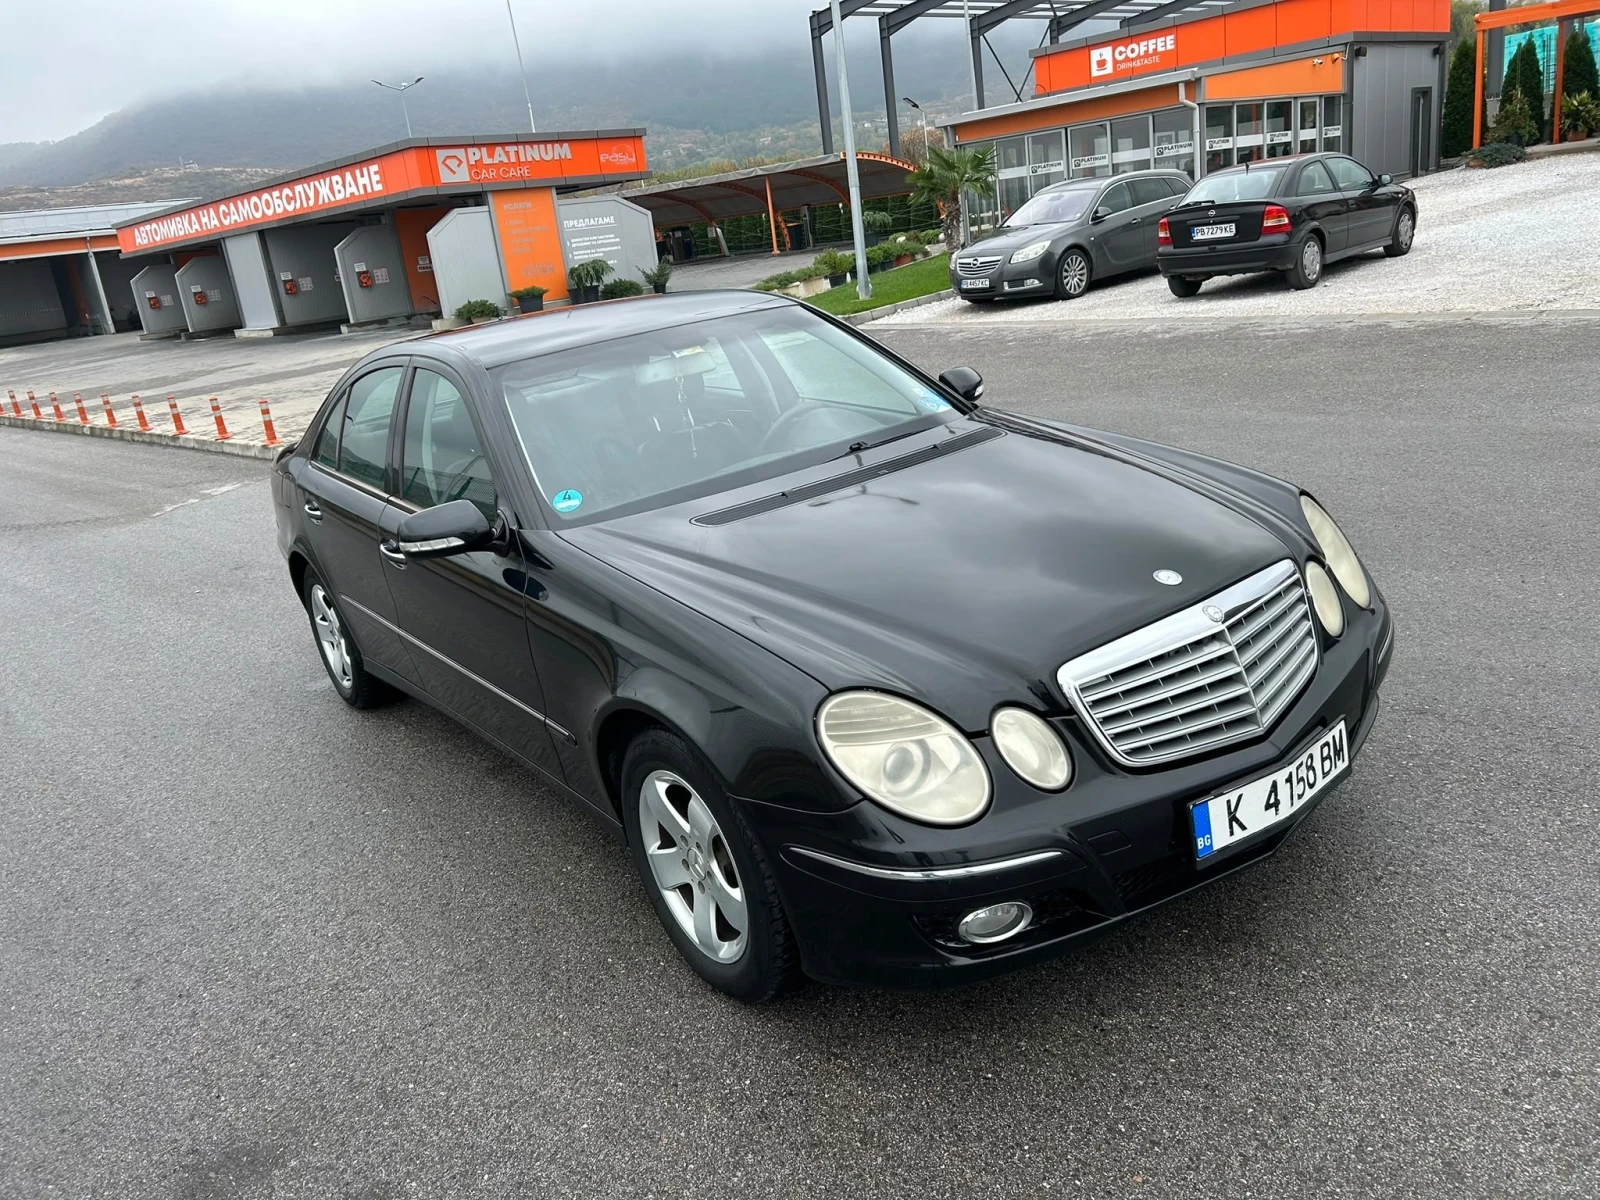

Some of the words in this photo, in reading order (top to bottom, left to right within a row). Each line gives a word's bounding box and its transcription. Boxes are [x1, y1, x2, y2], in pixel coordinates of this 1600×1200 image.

[1114, 34, 1175, 61] COFFEE
[1116, 55, 1160, 71] DRINK&TASTE
[467, 143, 572, 165] PLATINUM
[1163, 142, 1193, 151] PLATINUM
[600, 152, 636, 163] easy
[1081, 155, 1107, 163] PLATINUM
[471, 168, 497, 181] CAR
[499, 166, 531, 178] CARE
[134, 212, 201, 247] АВТОМИВКА
[200, 206, 221, 230] НА
[219, 164, 384, 226] САМООБСЛУЖВАНЕ
[563, 216, 615, 229] ПРЕДЛАГАМЕ
[1206, 226, 1224, 236] 7279
[1224, 224, 1235, 233] KE
[563, 491, 572, 500] 4
[1226, 793, 1248, 837] K
[1264, 752, 1317, 816] 4158
[1320, 728, 1345, 780] BM
[1197, 834, 1211, 850] BG
